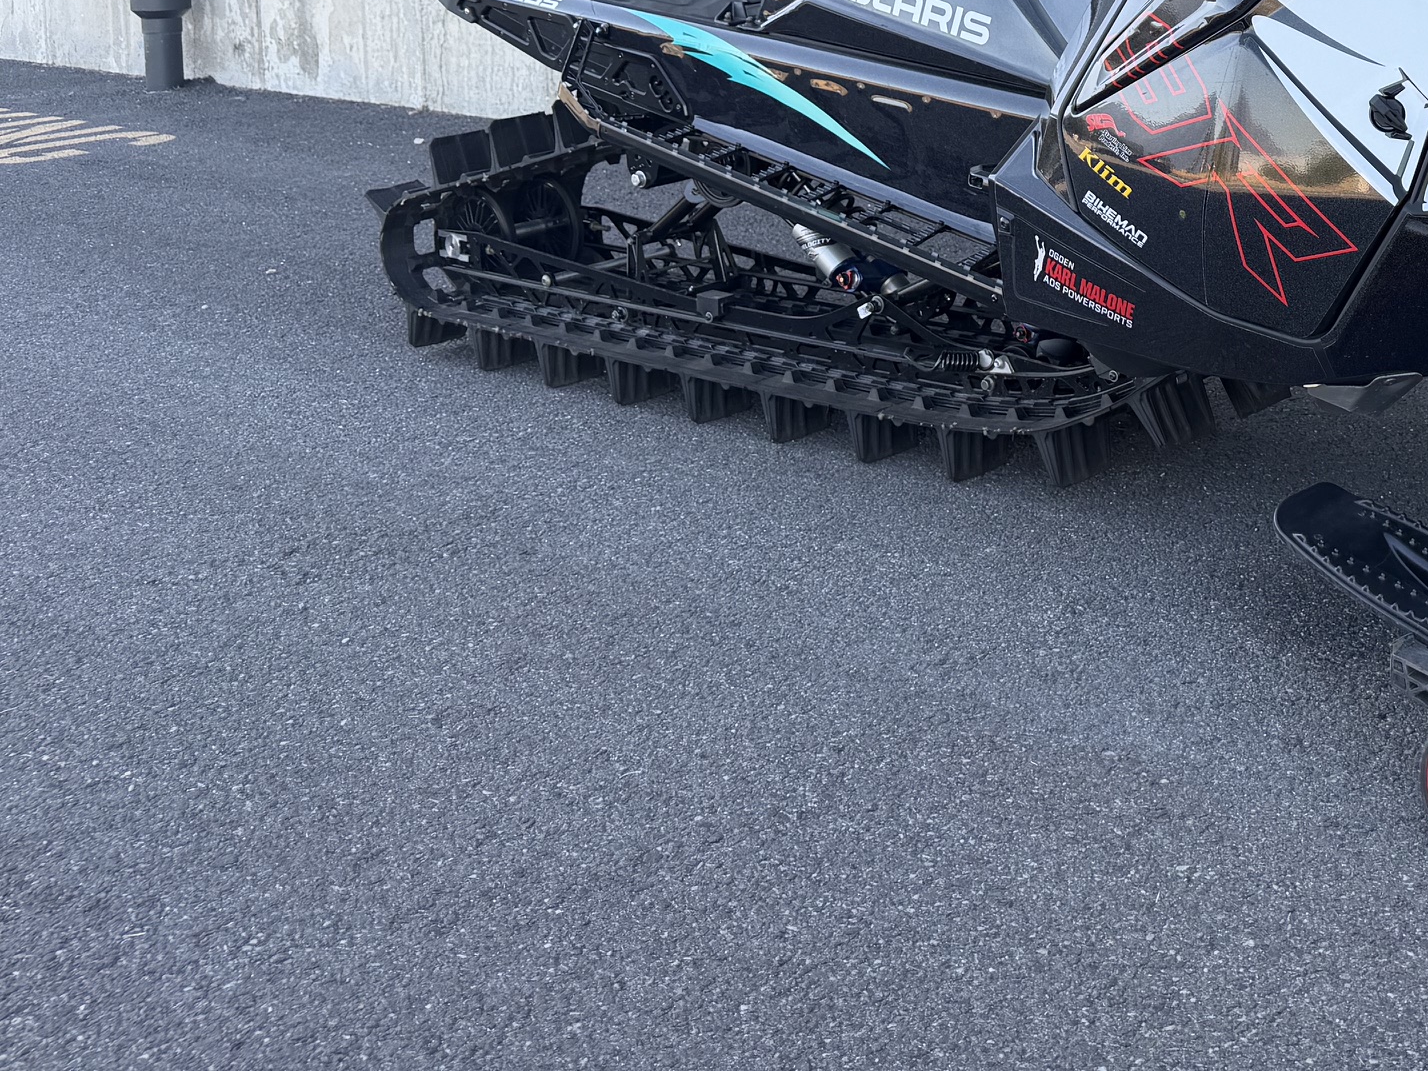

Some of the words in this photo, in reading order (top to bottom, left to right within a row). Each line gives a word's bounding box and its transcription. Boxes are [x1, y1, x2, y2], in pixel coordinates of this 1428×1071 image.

[1081, 197, 1145, 249] PERFORMANCE
[1048, 249, 1075, 271] OGDEN
[1043, 274, 1061, 291] ADS
[1062, 285, 1133, 329] POWERSPORTS
[1045, 258, 1077, 291] KARL
[1079, 278, 1136, 320] MALONE
